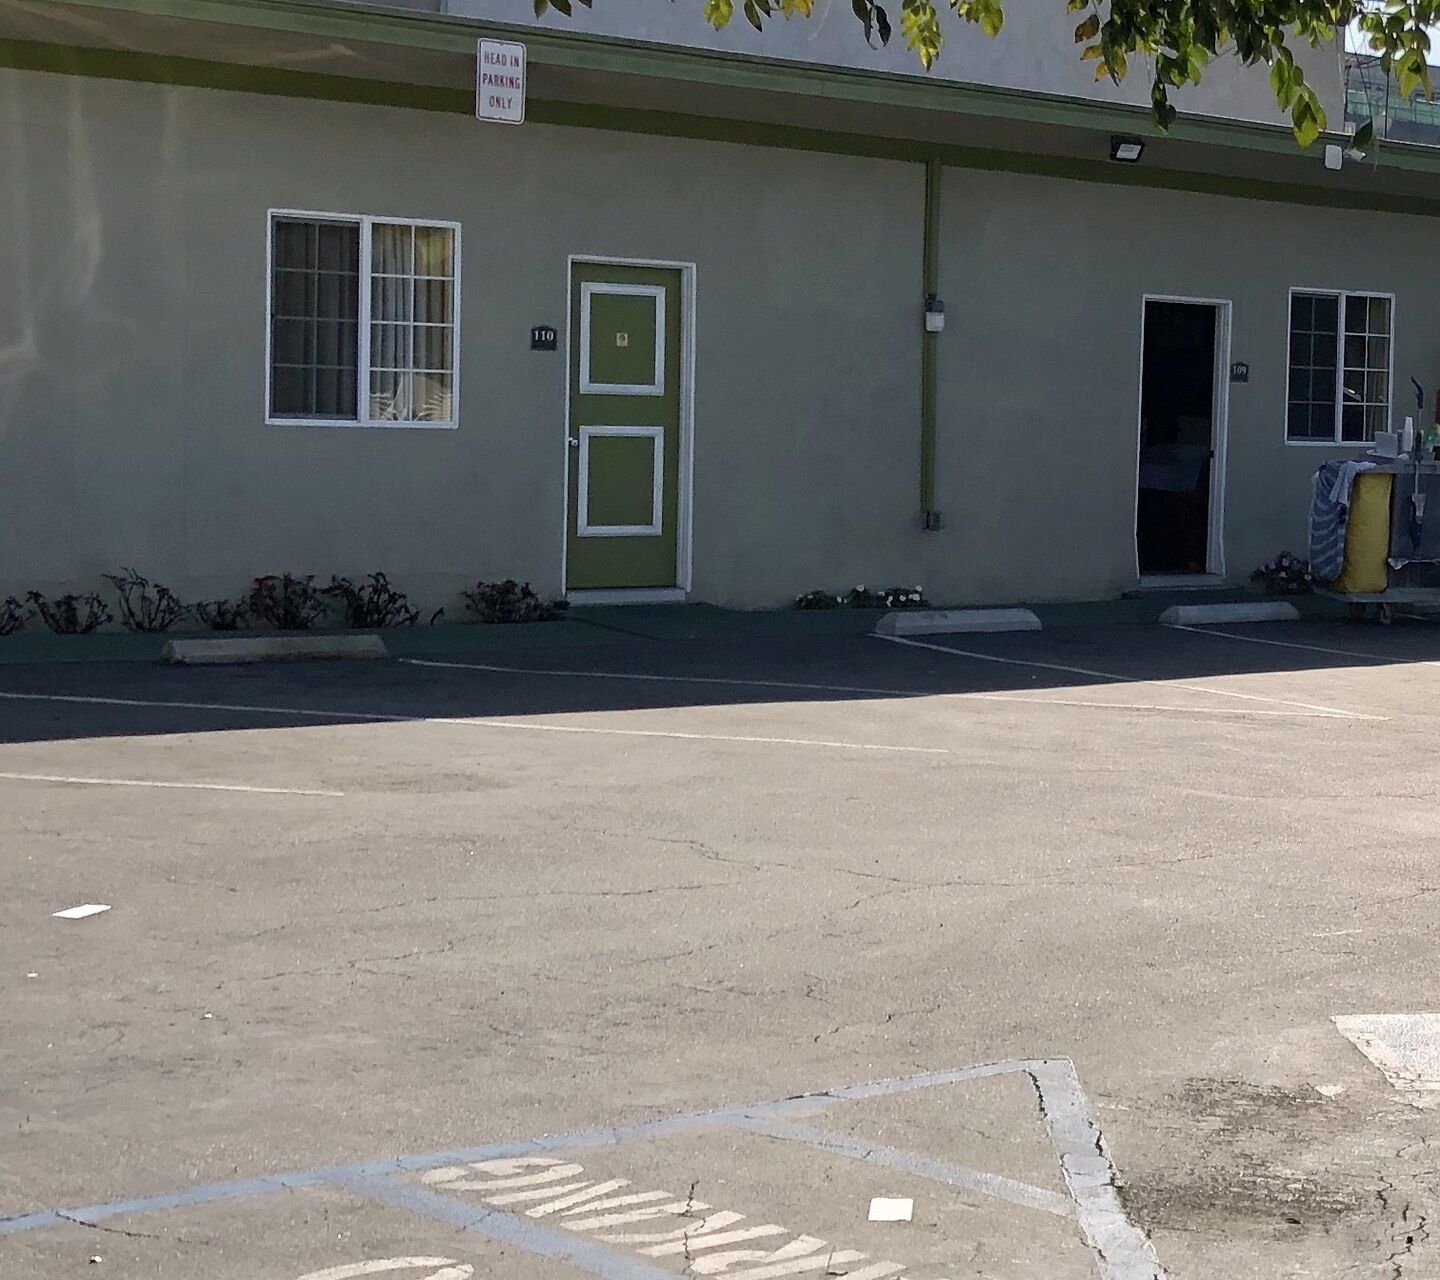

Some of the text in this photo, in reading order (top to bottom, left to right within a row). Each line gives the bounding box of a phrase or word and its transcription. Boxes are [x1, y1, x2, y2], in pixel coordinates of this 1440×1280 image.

[484, 52, 520, 68] HEAD IN
[482, 73, 521, 90] PARKING
[489, 95, 513, 110] ONLY
[534, 330, 554, 341] 110
